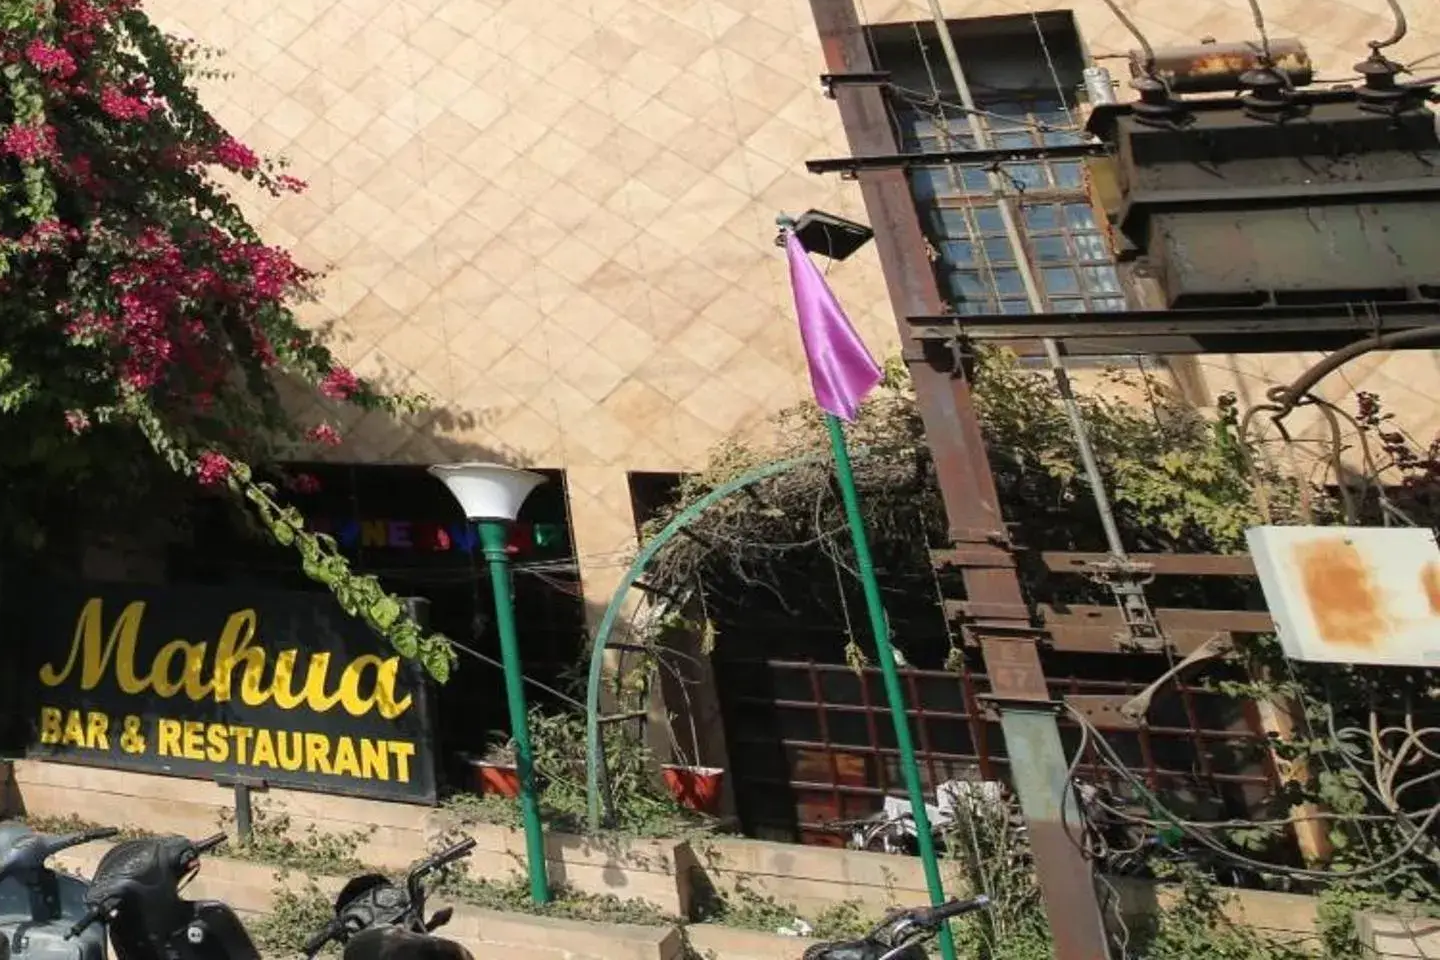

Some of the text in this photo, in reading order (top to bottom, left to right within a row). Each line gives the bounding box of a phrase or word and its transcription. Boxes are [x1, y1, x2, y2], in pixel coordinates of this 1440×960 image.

[40, 597, 413, 719] Mahua
[41, 707, 416, 783] BAR & RESTAURANT
